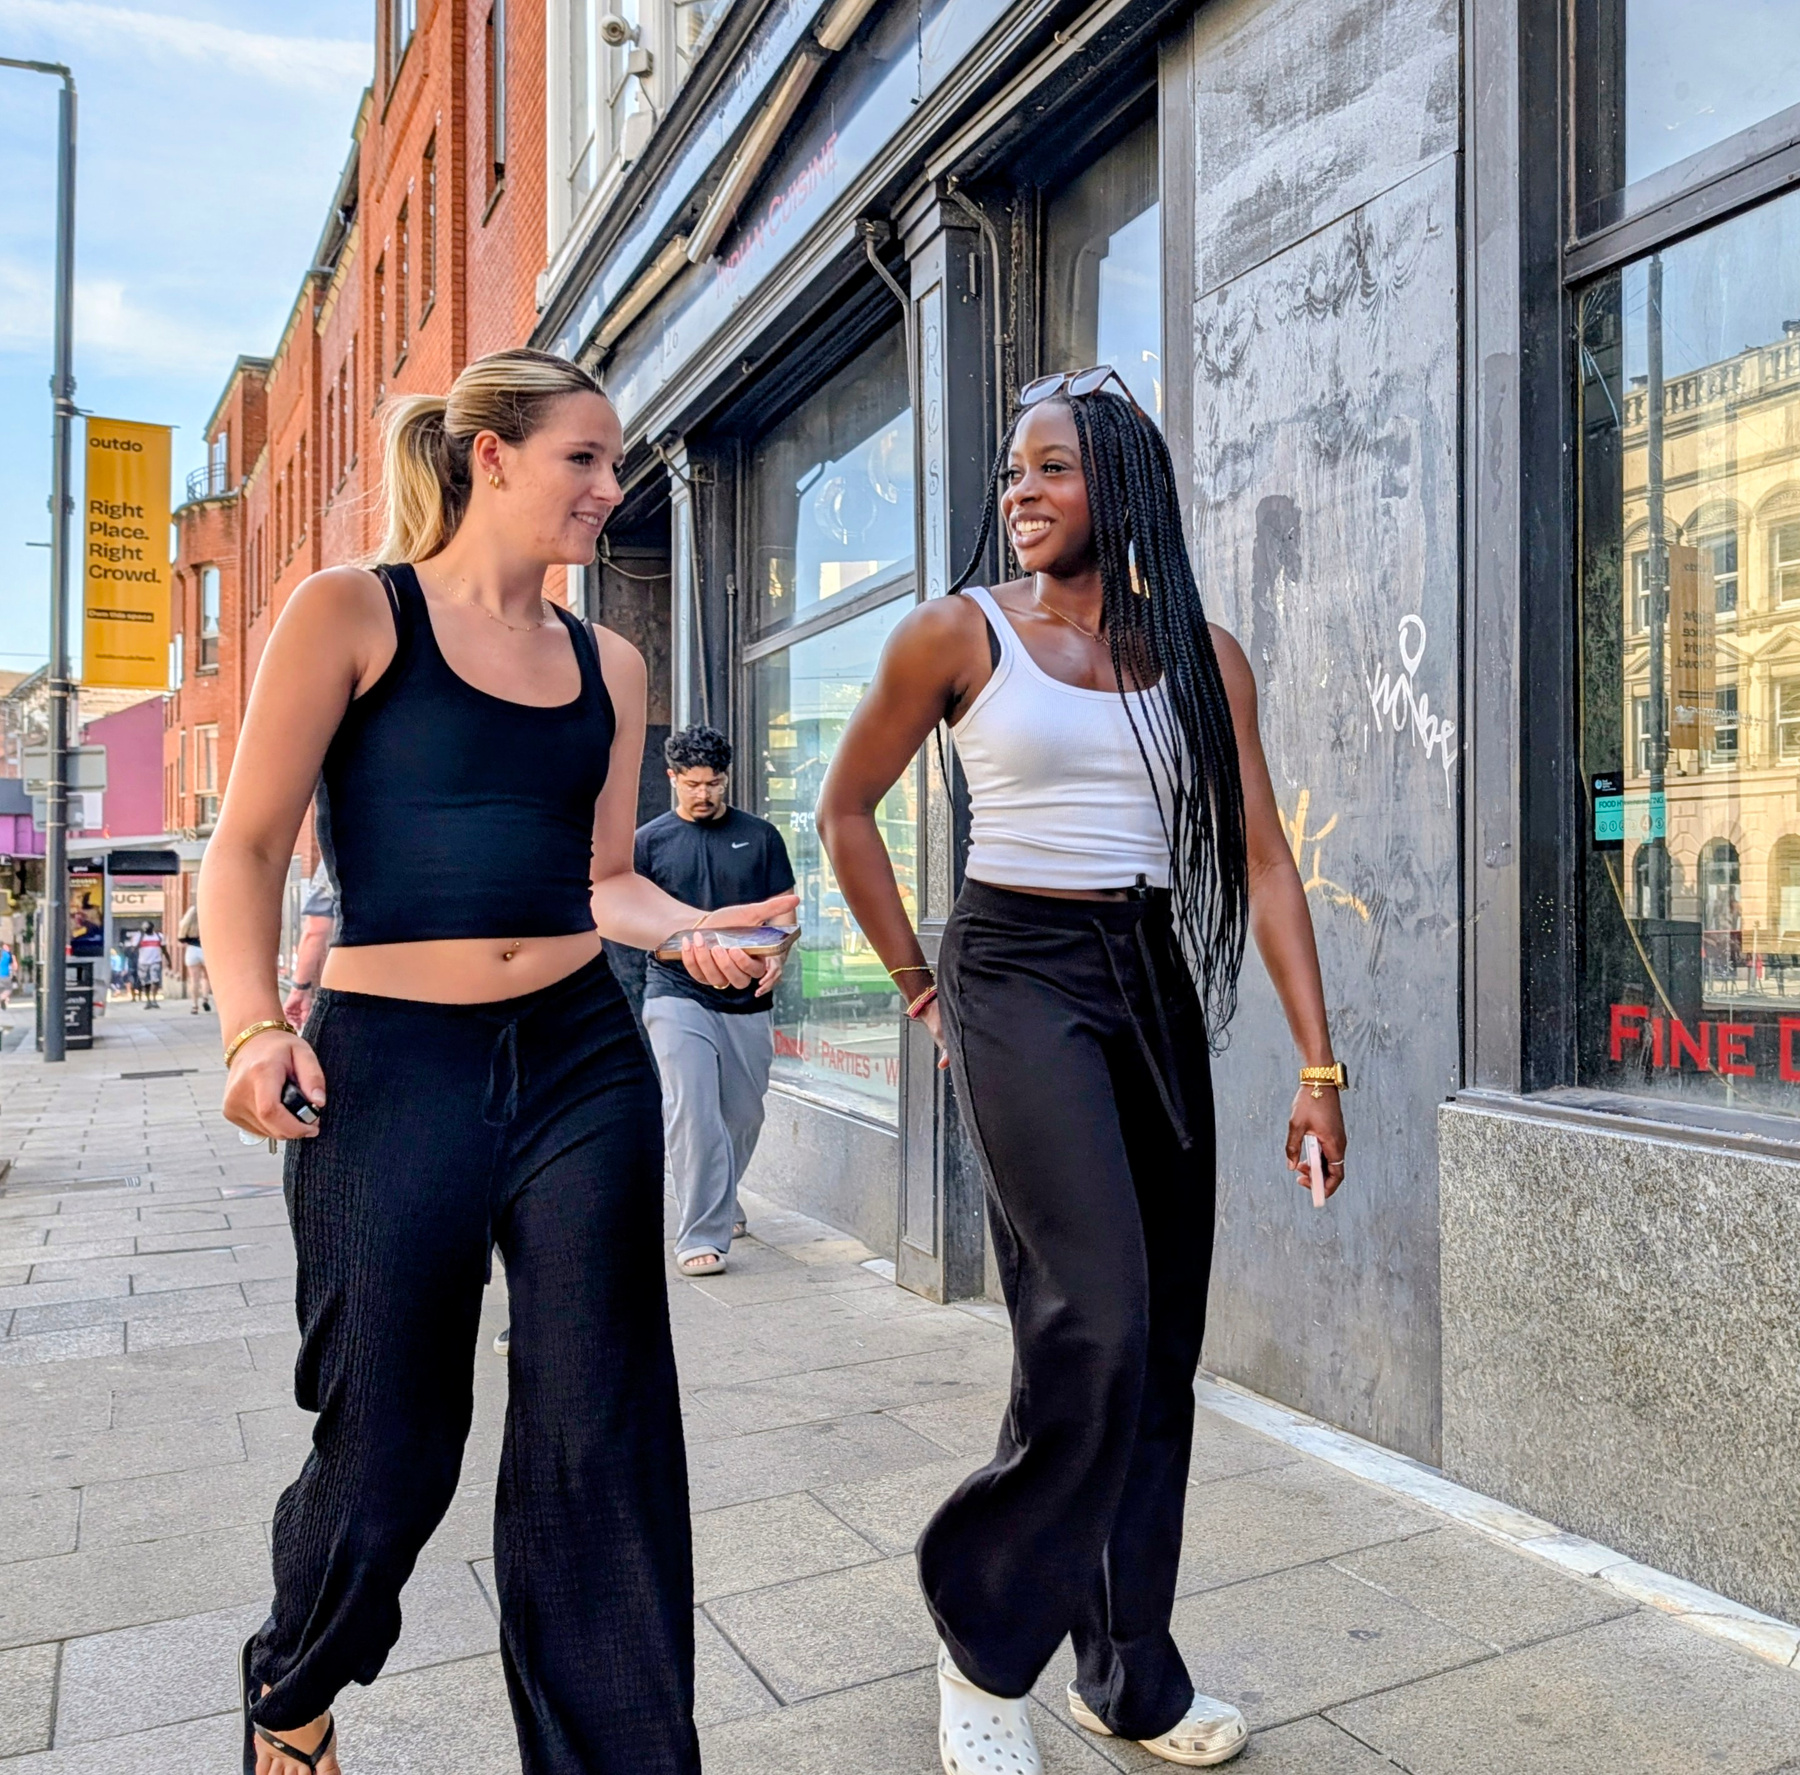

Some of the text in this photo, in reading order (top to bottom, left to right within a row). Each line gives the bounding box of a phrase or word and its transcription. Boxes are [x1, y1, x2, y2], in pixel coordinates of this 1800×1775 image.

[768, 131, 838, 237] CUISINE
[89, 437, 143, 453] outdo
[90, 500, 144, 519] Right
[89, 521, 150, 540] Place.
[89, 543, 143, 562] Right
[88, 564, 161, 583] Crowd.
[1598, 800, 1617, 808] FOOD
[112, 894, 147, 904] UCT
[1610, 1003, 1755, 1077] FINE
[821, 1040, 871, 1079] PARTIES
